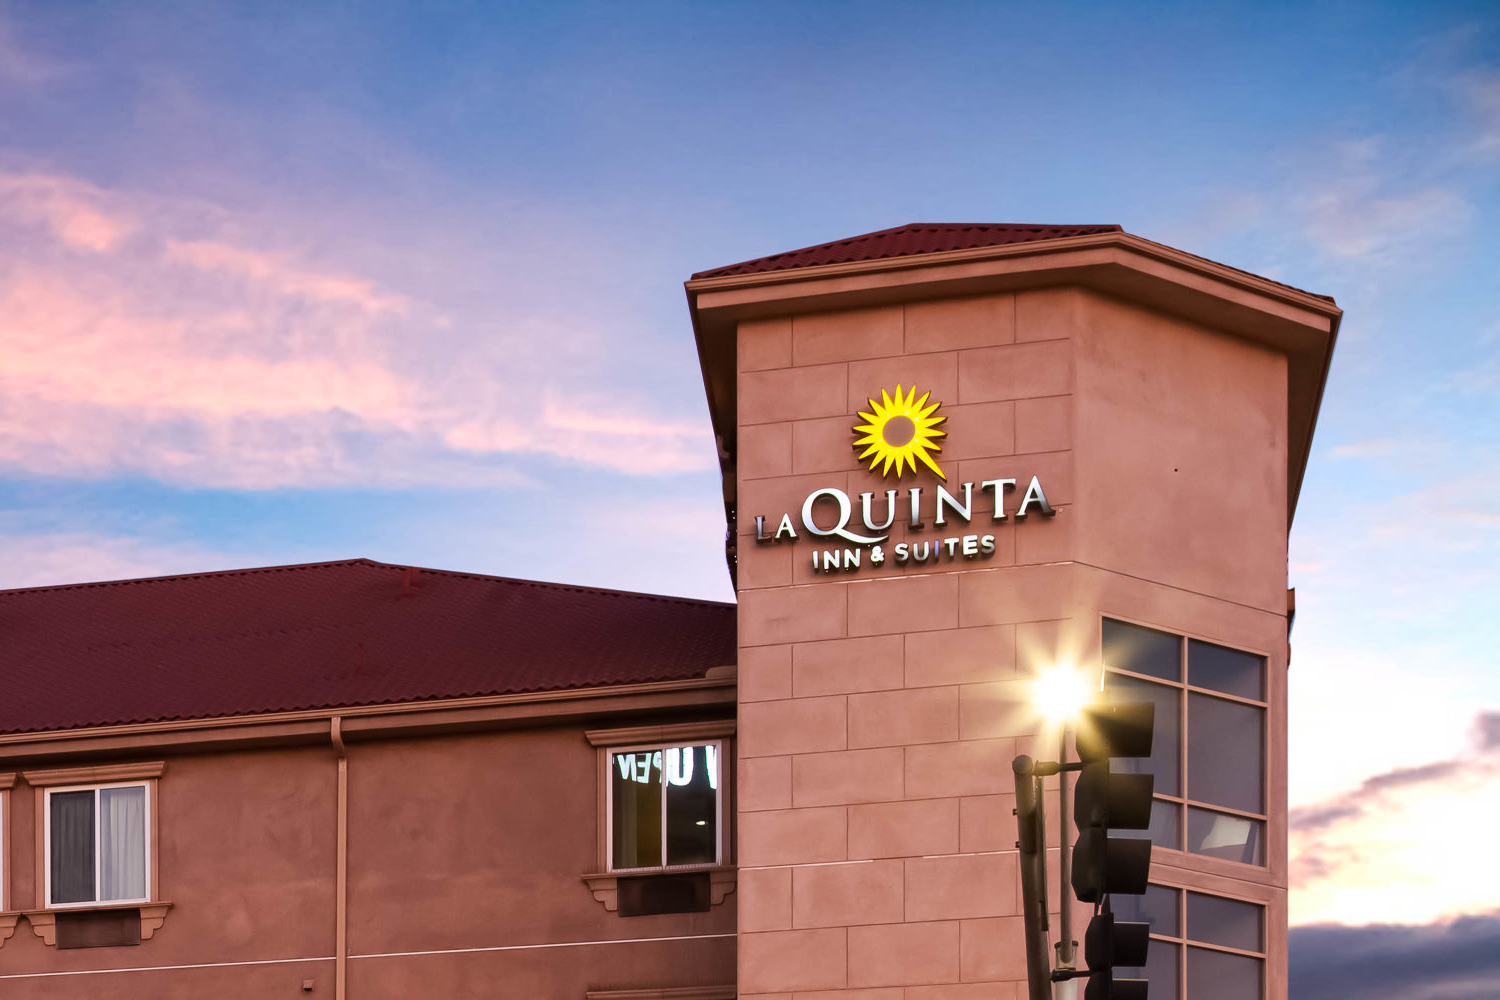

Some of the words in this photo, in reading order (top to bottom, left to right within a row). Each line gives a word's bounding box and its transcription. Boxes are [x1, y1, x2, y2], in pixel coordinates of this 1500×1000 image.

[801, 475, 1056, 544] QUINTA
[812, 548, 861, 573] INN
[869, 545, 885, 565] &
[894, 534, 996, 564] SUITES
